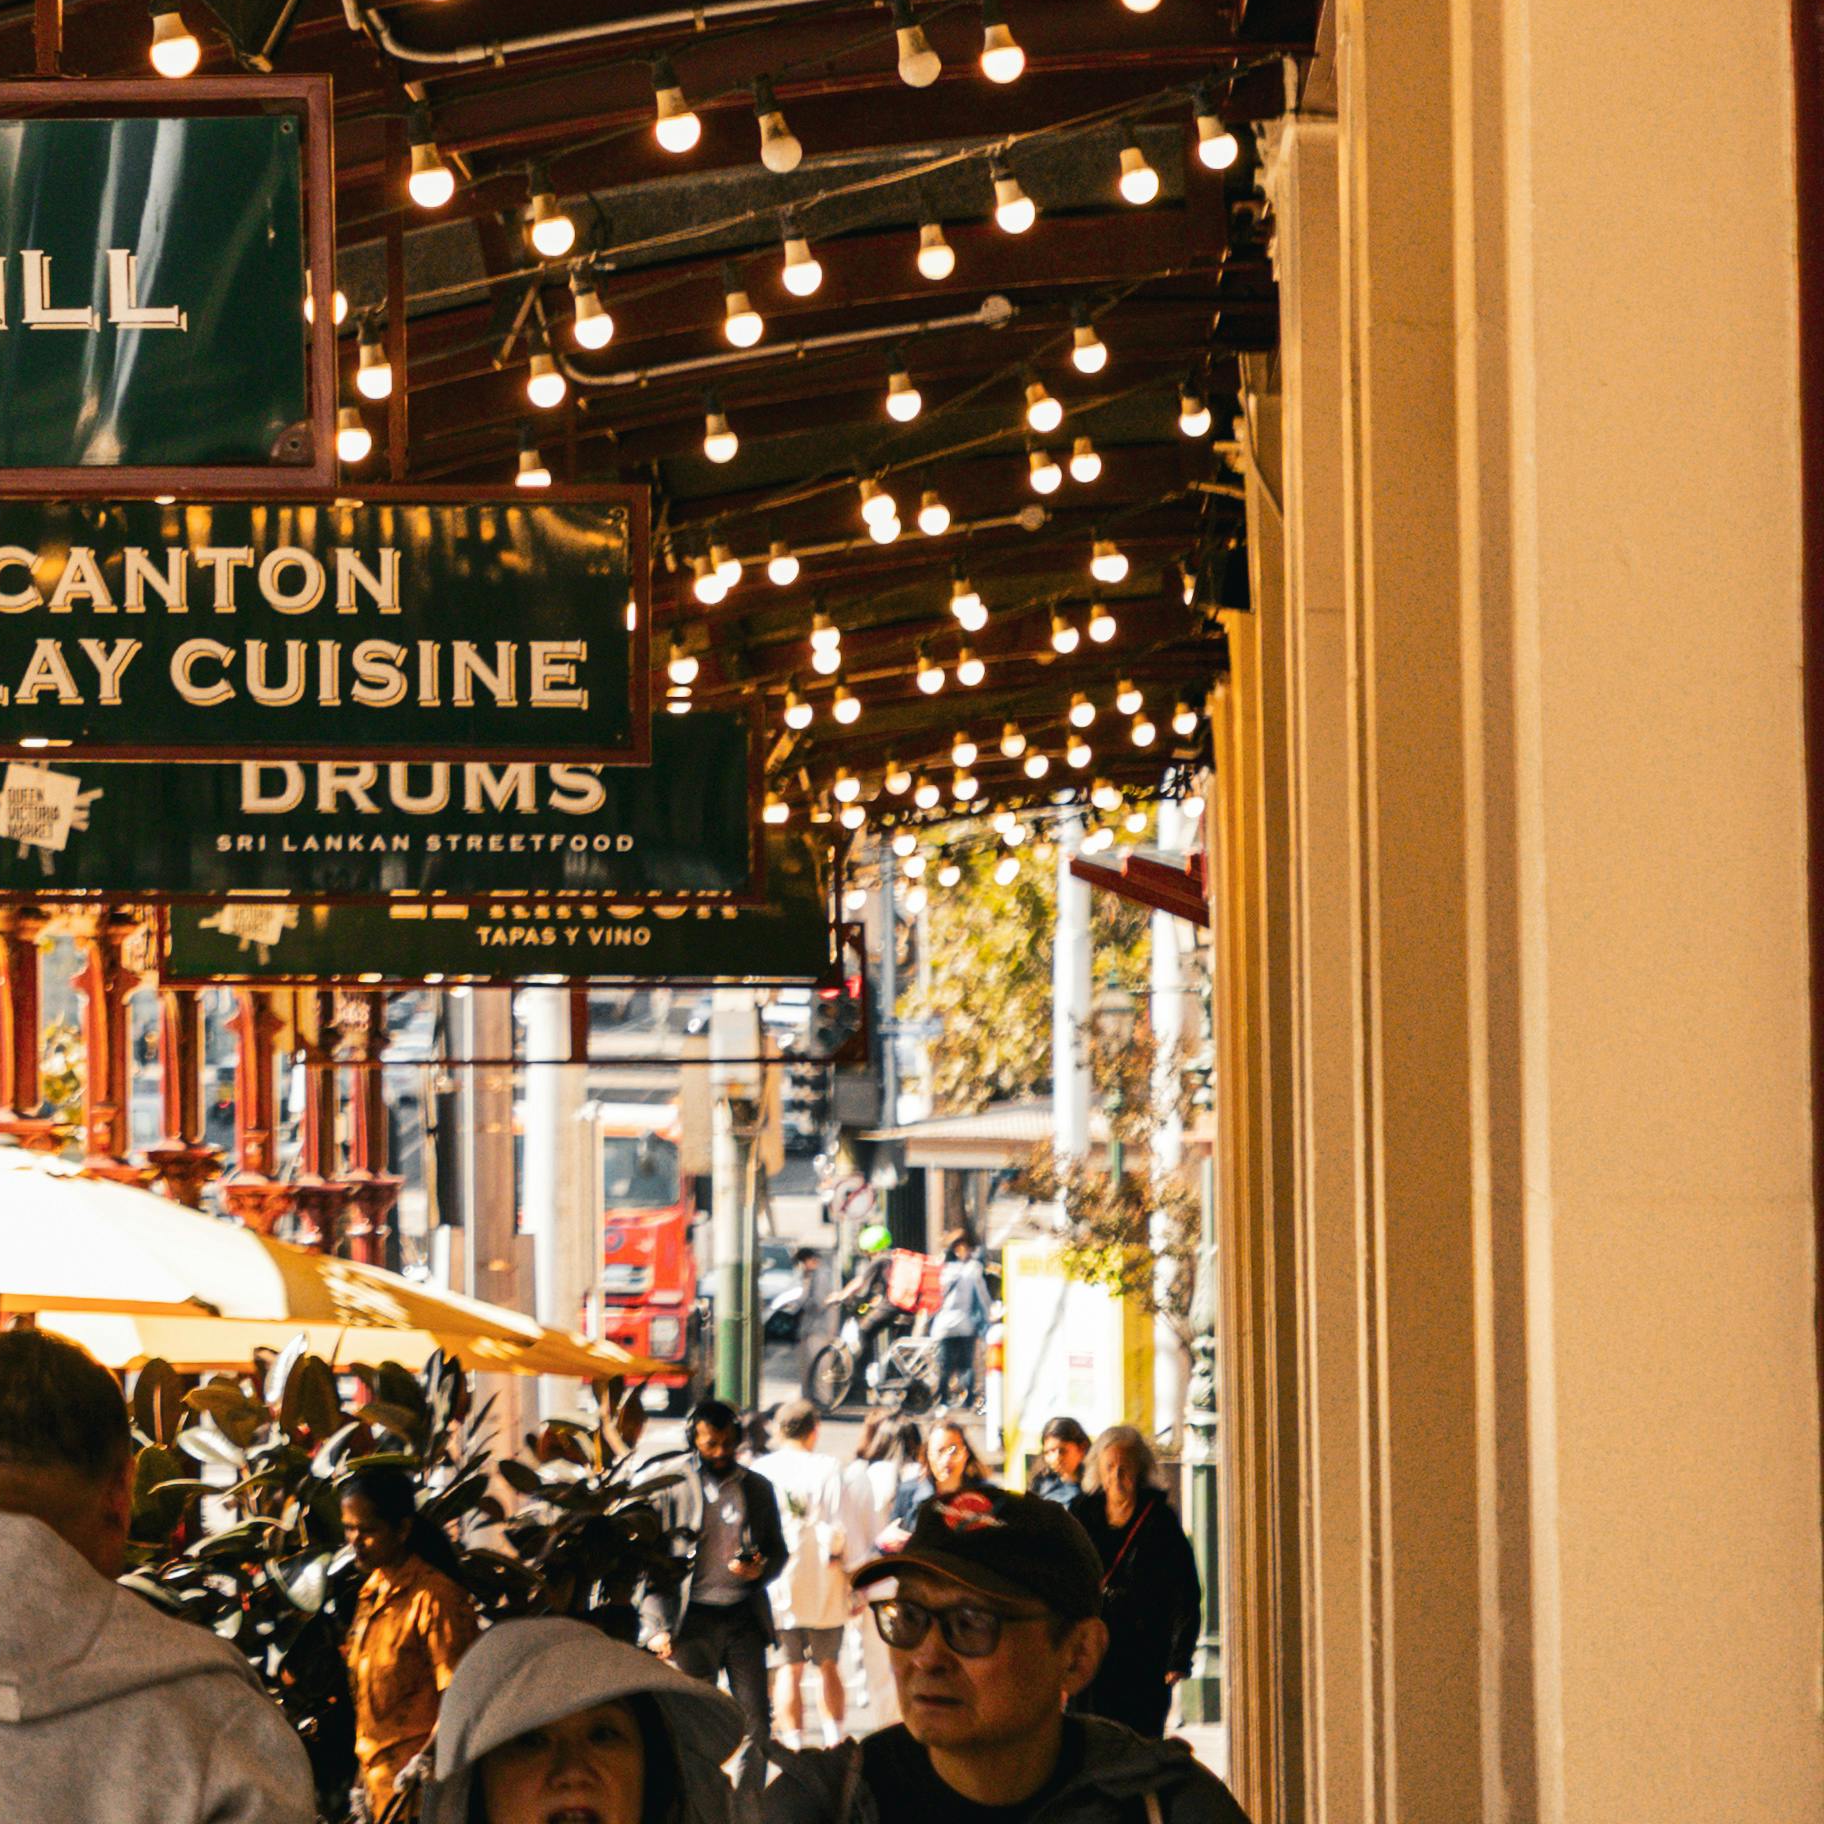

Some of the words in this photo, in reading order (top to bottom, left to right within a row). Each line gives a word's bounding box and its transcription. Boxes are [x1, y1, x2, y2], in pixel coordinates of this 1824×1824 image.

[169, 637, 589, 711] CUISINE
[240, 761, 608, 816] DRUMS
[215, 834, 267, 853] SRI
[282, 834, 411, 853] LANKAN
[425, 834, 636, 854] STREETFOOD
[476, 925, 557, 947] TAPAS
[563, 926, 580, 946] Y
[587, 926, 652, 947] VINO
